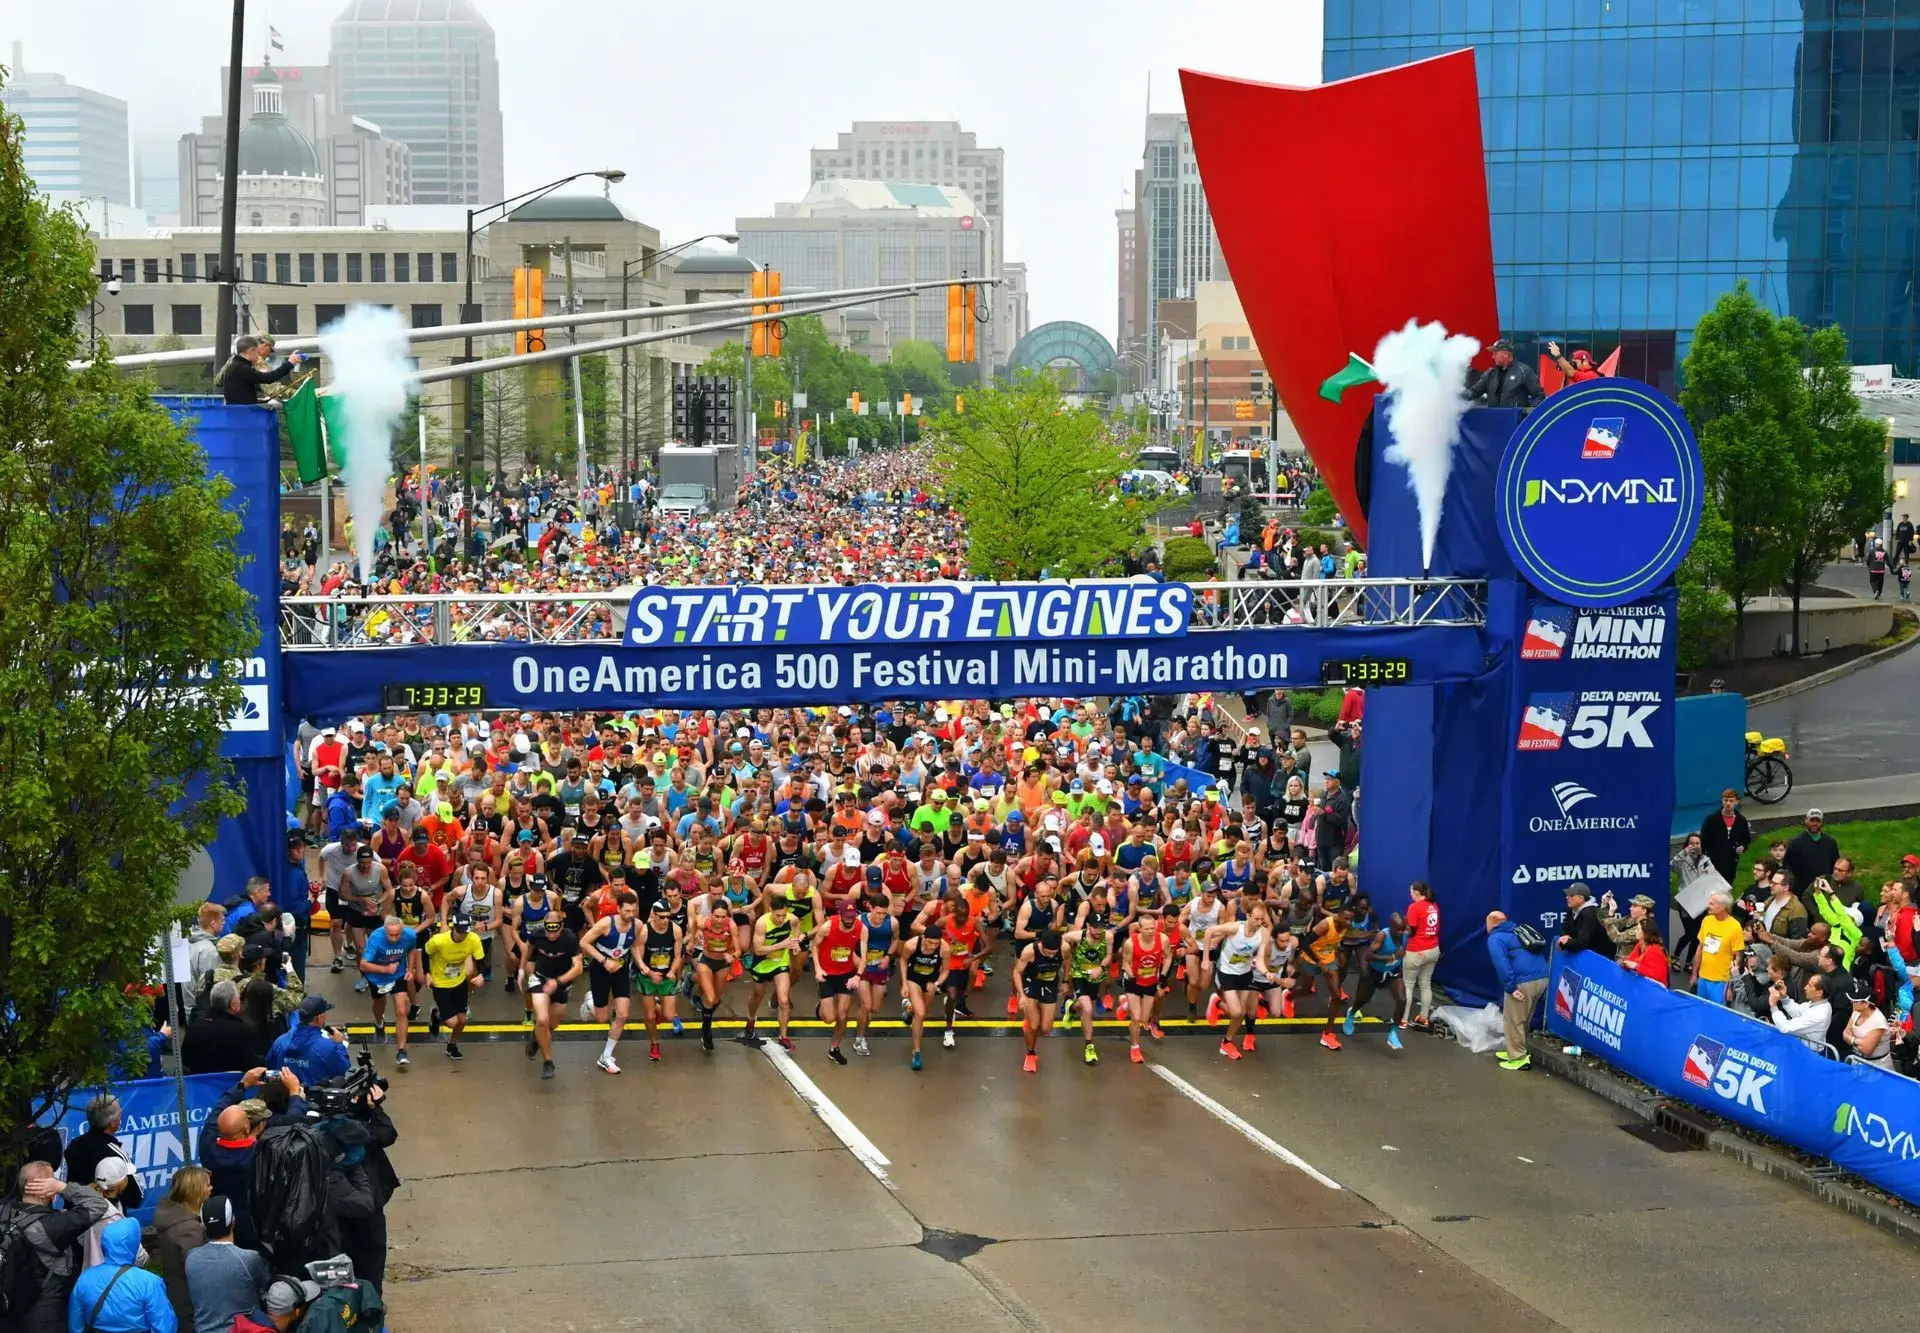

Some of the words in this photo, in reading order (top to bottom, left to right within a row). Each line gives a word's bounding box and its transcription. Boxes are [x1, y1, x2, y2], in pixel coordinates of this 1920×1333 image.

[631, 593, 803, 645] START
[817, 592, 955, 641] YOUR
[965, 588, 1188, 638] ENGINES
[1573, 616, 1666, 644] MINI
[1522, 648, 1535, 658] 500
[1534, 648, 1561, 658] FESTIVAL
[1570, 643, 1662, 659] MARATHON
[512, 654, 762, 694] OneAmerica
[775, 653, 840, 690] 500
[853, 650, 999, 689] Festival
[1013, 646, 1289, 685] Mini-Marathon
[1580, 691, 1614, 702] DELTA
[1616, 691, 1662, 702] DENTAL
[1567, 705, 1661, 749] 5K
[1518, 739, 1530, 749] 500
[1531, 738, 1559, 748] FESTIVAL
[1535, 866, 1583, 882] DELTA
[1586, 863, 1651, 879] DENTAL
[385, 947, 404, 957] RUN
[1576, 988, 1626, 1037] MINI
[1575, 1013, 1621, 1051] MARATHON
[1726, 1047, 1749, 1064] DELTA
[1750, 1055, 1778, 1075] DENTAL
[1713, 1058, 1774, 1115] 5K
[78, 1107, 213, 1135] OAMERIC
